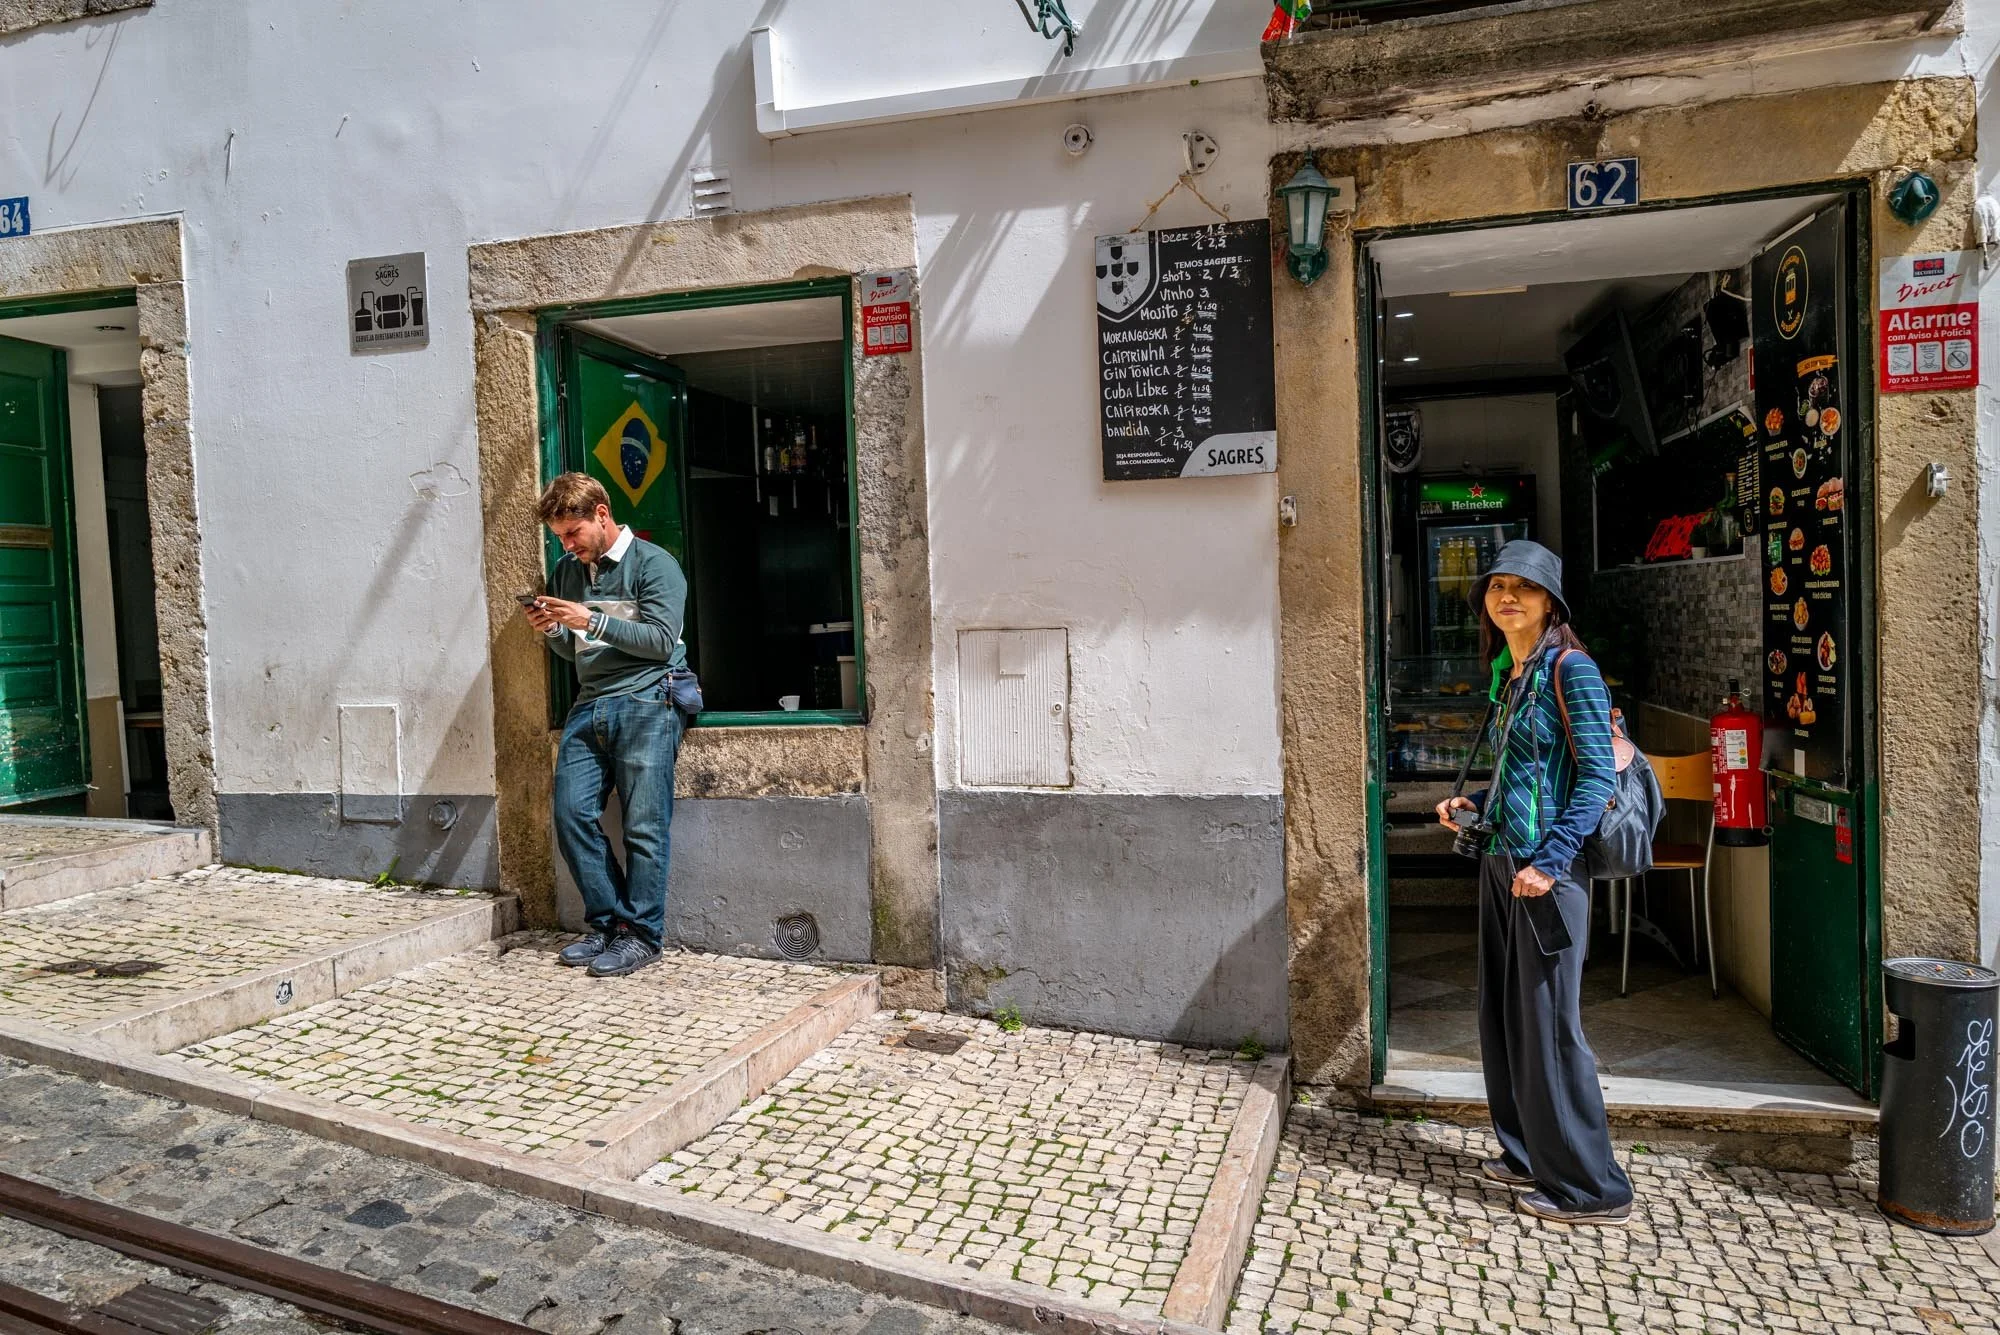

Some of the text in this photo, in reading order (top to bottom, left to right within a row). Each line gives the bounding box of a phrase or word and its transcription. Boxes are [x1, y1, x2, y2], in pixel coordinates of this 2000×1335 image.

[1575, 162, 1627, 206] 62
[0, 203, 24, 234] 64
[1174, 260, 1203, 269] TEMOS
[1203, 256, 1237, 266] SAGRES
[375, 268, 400, 281] SAGRES
[1896, 273, 1964, 302] Direct
[872, 305, 901, 315] Alarme
[866, 312, 908, 324] Zerovision
[1887, 311, 1972, 332] Alarme
[1887, 334, 1906, 342] com
[1908, 331, 1932, 340] Aviso
[1207, 446, 1264, 467] SAGRES
[1451, 499, 1504, 511] Heineken
